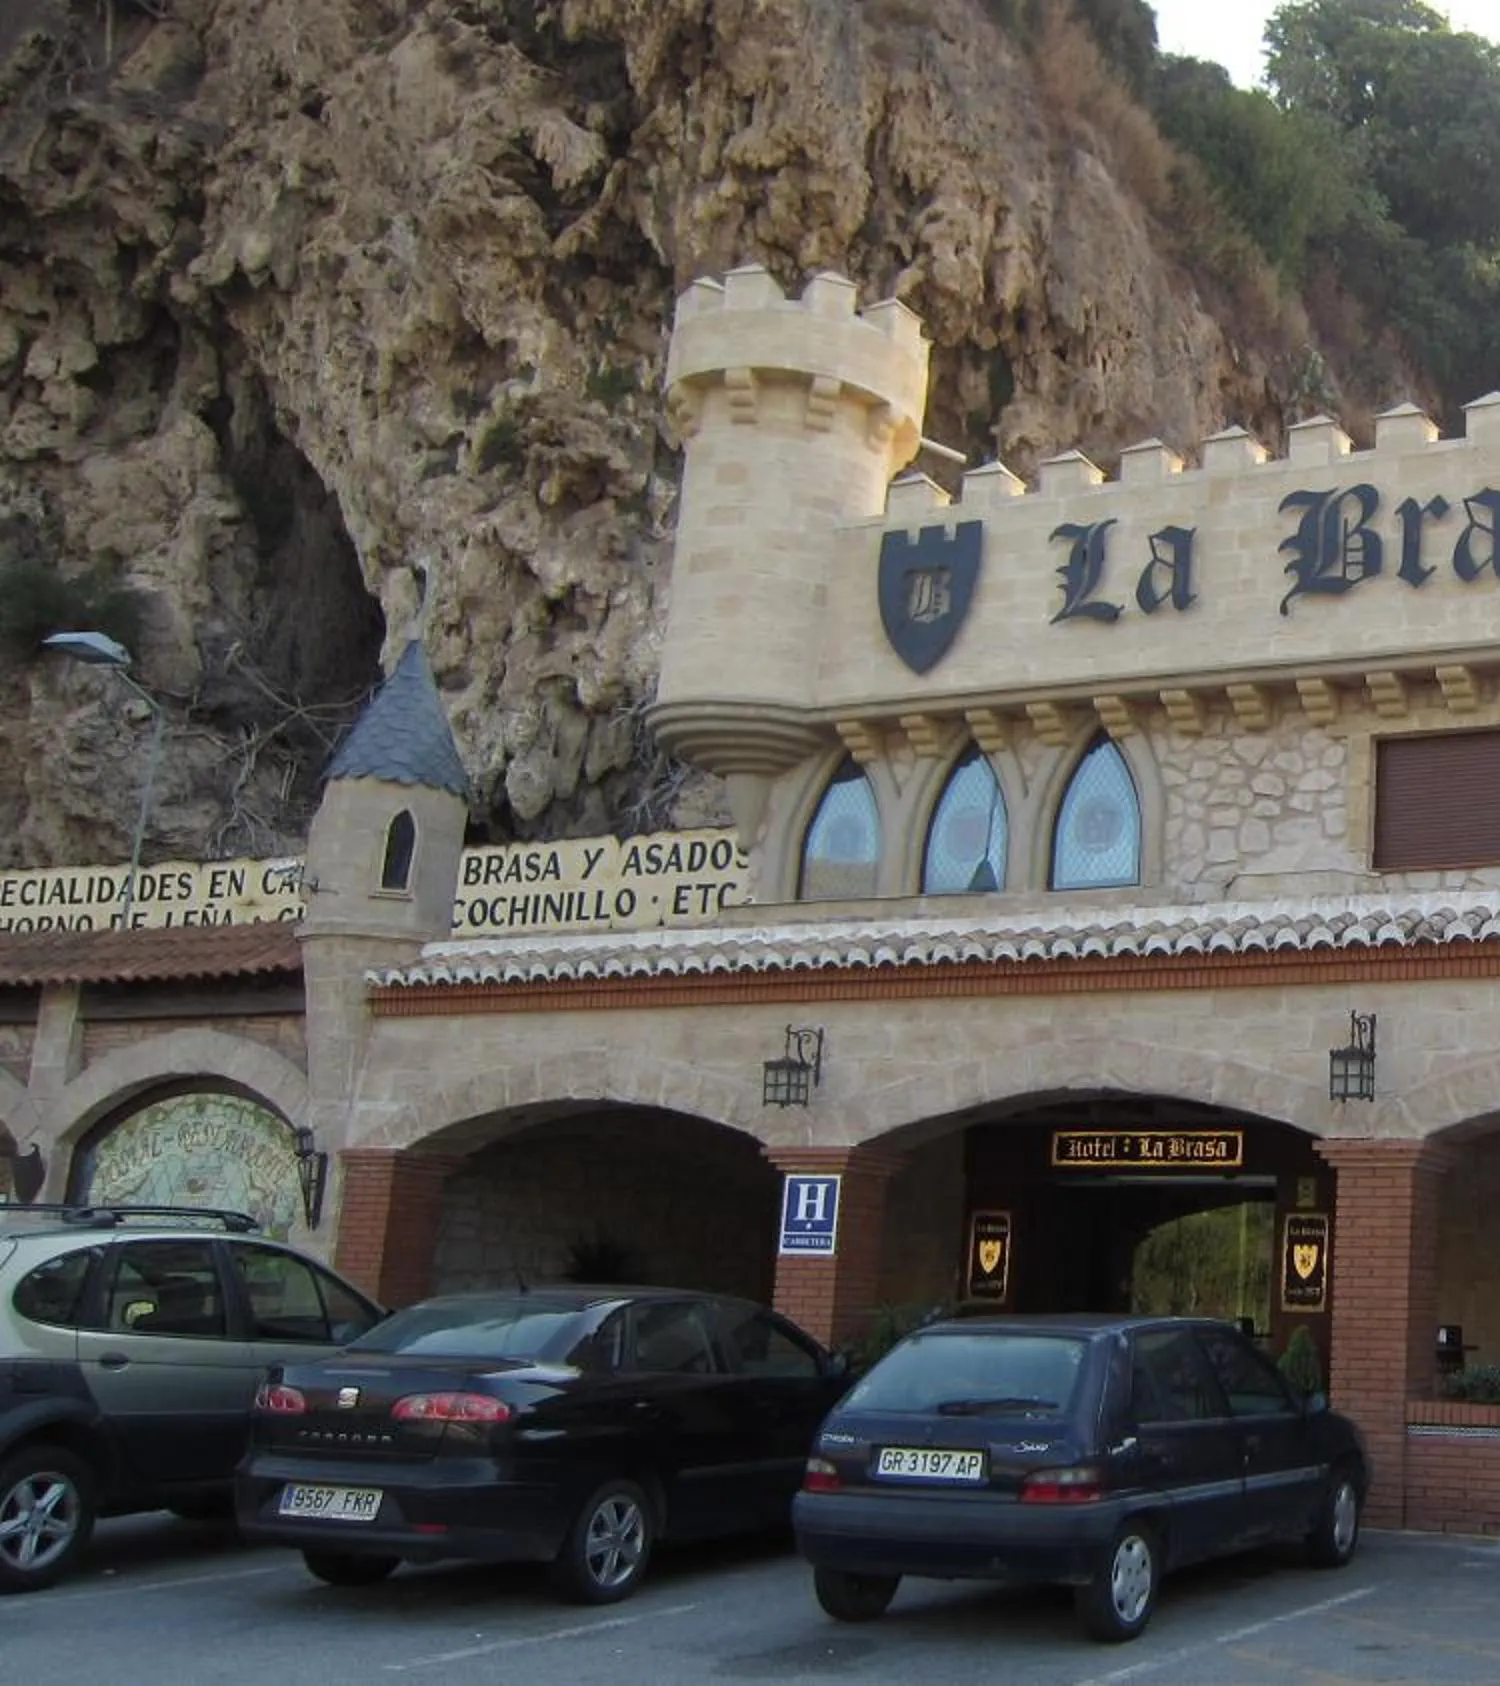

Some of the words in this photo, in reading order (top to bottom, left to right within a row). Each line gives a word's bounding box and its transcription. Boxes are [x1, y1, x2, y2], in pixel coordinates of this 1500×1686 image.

[1049, 518, 1197, 625] La
[208, 868, 246, 899] EN
[463, 851, 561, 886] BRASA
[580, 847, 604, 879] Y
[621, 838, 749, 877] ASADOS
[452, 887, 637, 929] COCHINILLO
[1067, 1137, 1116, 1158] Hotel
[1138, 1137, 1164, 1158] La
[1167, 1138, 1228, 1160] Brasa
[793, 1183, 830, 1221] H
